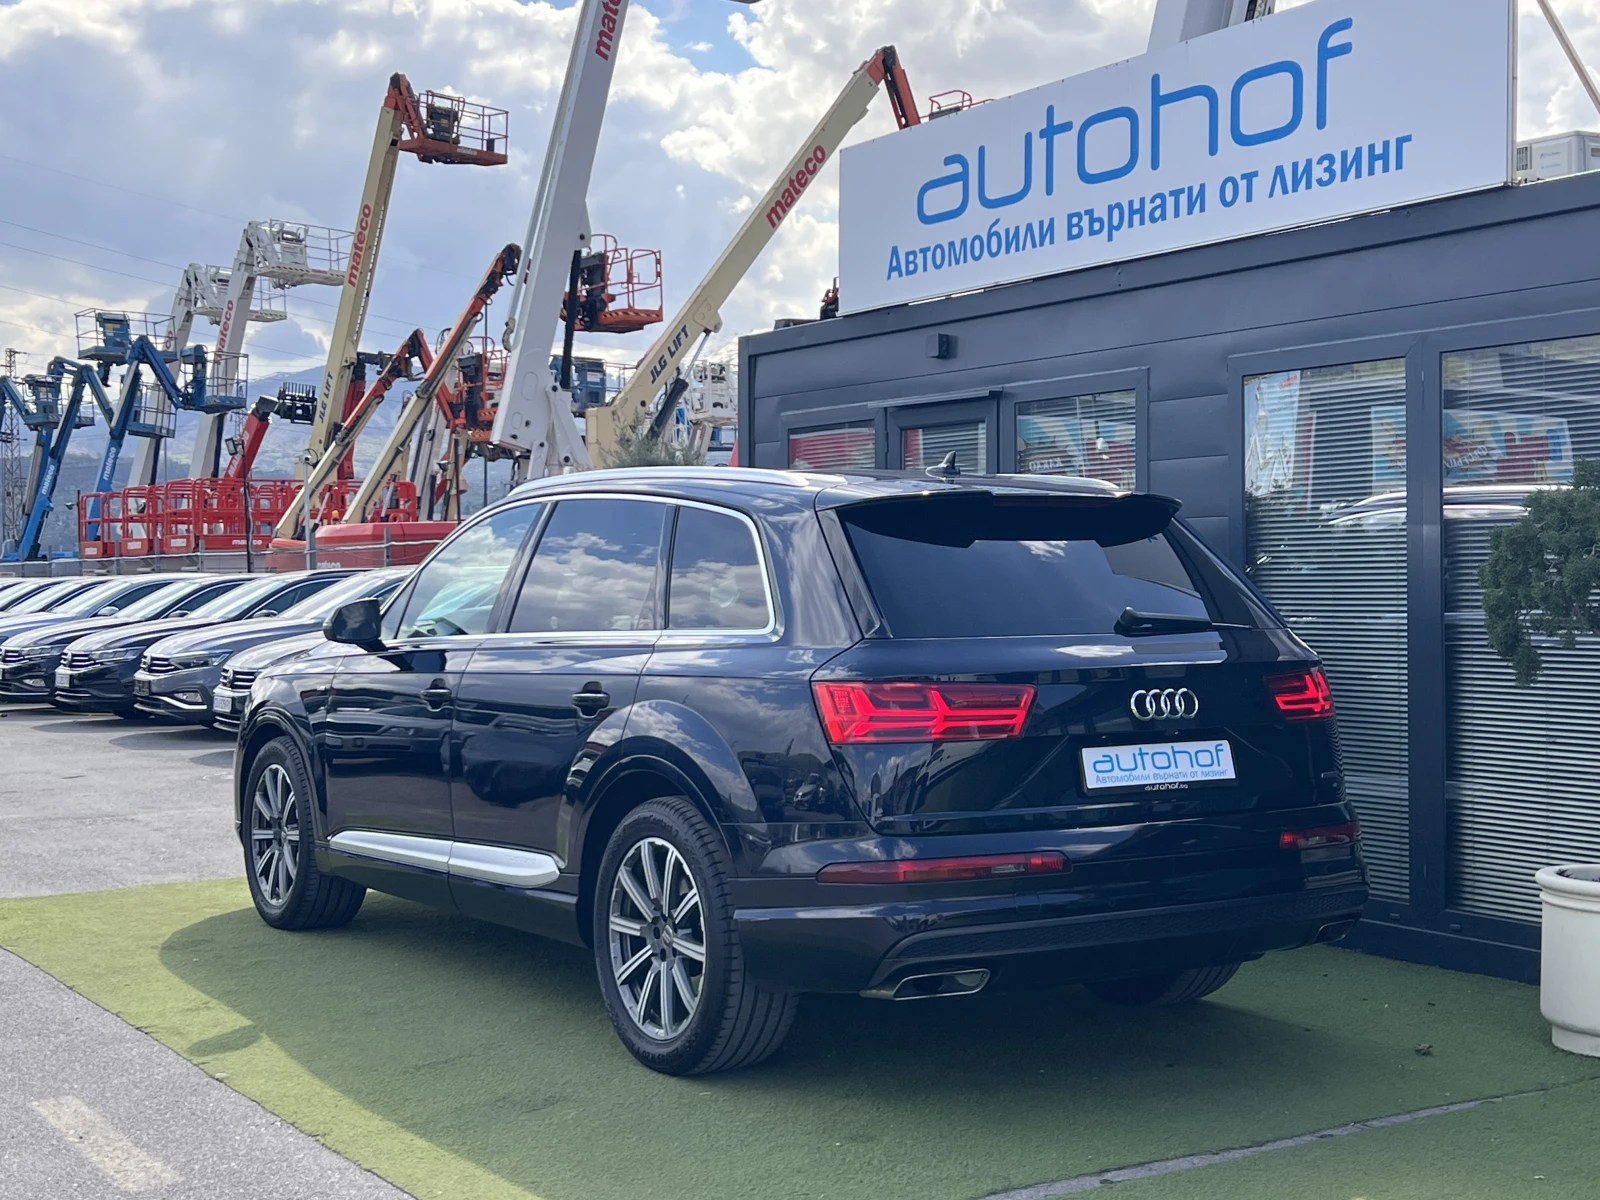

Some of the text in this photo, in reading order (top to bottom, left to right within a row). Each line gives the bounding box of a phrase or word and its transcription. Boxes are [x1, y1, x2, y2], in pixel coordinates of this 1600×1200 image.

[917, 17, 1353, 226] autohof
[766, 145, 826, 229] mateco
[886, 134, 1413, 281] Автомобили върнати от лизинг
[348, 204, 371, 288] mateco
[651, 324, 689, 385] JLG LIFT
[319, 371, 334, 424] JLG LIFT
[41, 464, 55, 495] mateco
[103, 446, 117, 481] mateco
[1092, 744, 1224, 773] autohof
[1095, 769, 1229, 784] Автомобили върнати от лизинг
